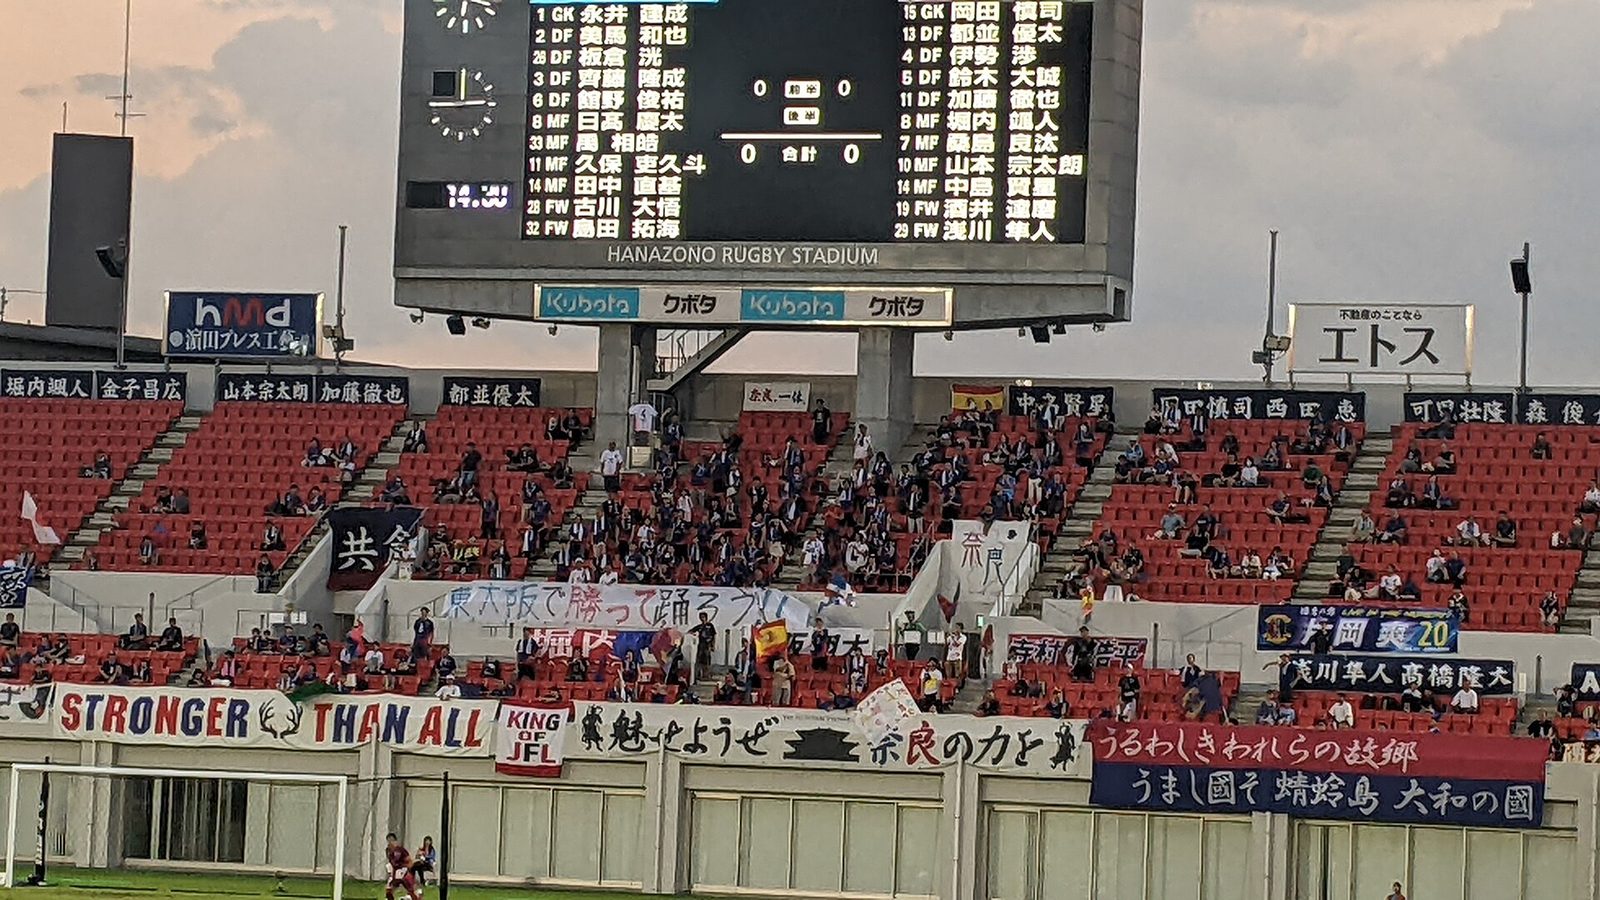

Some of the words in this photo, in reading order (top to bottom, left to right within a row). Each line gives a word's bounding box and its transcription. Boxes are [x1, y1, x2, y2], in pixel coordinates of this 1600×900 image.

[538, 8, 544, 21] 1
[552, 7, 574, 21] GK
[580, 3, 628, 24] 永井
[904, 5, 916, 19] 15
[921, 4, 944, 19] GK
[951, 2, 999, 22] 岡田
[536, 29, 545, 43] 2
[552, 28, 573, 43] DF
[580, 25, 626, 46] 美馬
[639, 25, 686, 46] 和也
[903, 27, 916, 41] 13
[921, 26, 942, 41] DF
[950, 22, 999, 44] 都並
[1012, 22, 1062, 44] 優太
[551, 50, 572, 64] DF
[902, 49, 913, 63] 4
[920, 48, 942, 62] DF
[533, 72, 544, 86] 3
[550, 71, 571, 85] DF
[638, 67, 685, 89] 隆成
[902, 70, 912, 85] 5
[919, 70, 941, 84] DF
[949, 66, 998, 88] 鈴木
[753, 79, 767, 97] 0
[838, 79, 851, 97] 0
[533, 93, 543, 107] 6
[549, 93, 570, 107] DF
[901, 92, 912, 107] 11
[918, 91, 940, 106] DF
[948, 88, 997, 110] 加藤
[532, 115, 542, 129] 8
[547, 114, 569, 128] MF
[901, 114, 911, 129] 8
[916, 113, 939, 128] MF
[947, 110, 996, 132] 堀内
[530, 136, 543, 150] 33
[546, 135, 569, 150] MF
[900, 135, 910, 150] 7
[916, 135, 939, 150] MF
[530, 157, 541, 171] 11
[546, 157, 568, 171] MF
[575, 154, 622, 174] 久保
[740, 143, 757, 164] 0
[781, 145, 818, 162] 合計
[843, 143, 860, 164] 0
[898, 158, 911, 172] 10
[914, 157, 938, 172] MF
[946, 154, 994, 176] 山本
[1008, 154, 1083, 176] 宗太朗
[529, 178, 541, 192] 14
[545, 178, 567, 192] MF
[575, 175, 621, 196] 田中
[634, 175, 681, 196] 直基
[898, 180, 910, 194] 14
[914, 179, 937, 194] MF
[945, 176, 993, 197] 中島
[527, 200, 540, 214] 28
[546, 199, 569, 214] FW
[574, 196, 619, 218] 古川
[897, 201, 909, 217] 19
[915, 201, 939, 216] FW
[944, 198, 993, 220] 酒井
[527, 221, 539, 235] 32
[545, 220, 568, 235] FW
[573, 218, 619, 239] 島田
[632, 218, 680, 239] 拓海
[895, 223, 908, 238] 29
[914, 223, 939, 238] FW
[943, 219, 991, 242] 浅川
[607, 246, 716, 263] HANAZONO
[721, 247, 786, 264] RUGBY
[792, 247, 879, 265] STADIUM
[546, 292, 630, 313] Kubota
[663, 293, 717, 315] クボタ
[750, 294, 835, 315] Kubota
[868, 296, 925, 317] クボタ
[1339, 309, 1422, 320] 不動産のことなら
[1318, 323, 1440, 368] エトス
[100, 377, 182, 400] 金子昌広
[223, 380, 309, 402] 山本宗太朗
[449, 383, 535, 407] 都並優太
[1418, 620, 1449, 648] 20
[61, 693, 250, 738] STRONGER
[314, 703, 411, 744] THAN
[417, 705, 482, 747] ALL
[507, 710, 560, 731] KING
[518, 730, 546, 742] OF
[507, 742, 556, 763] JFL
[1100, 727, 1418, 773] うるわしきわれらの故郷
[1393, 779, 1533, 821] 大和の國
